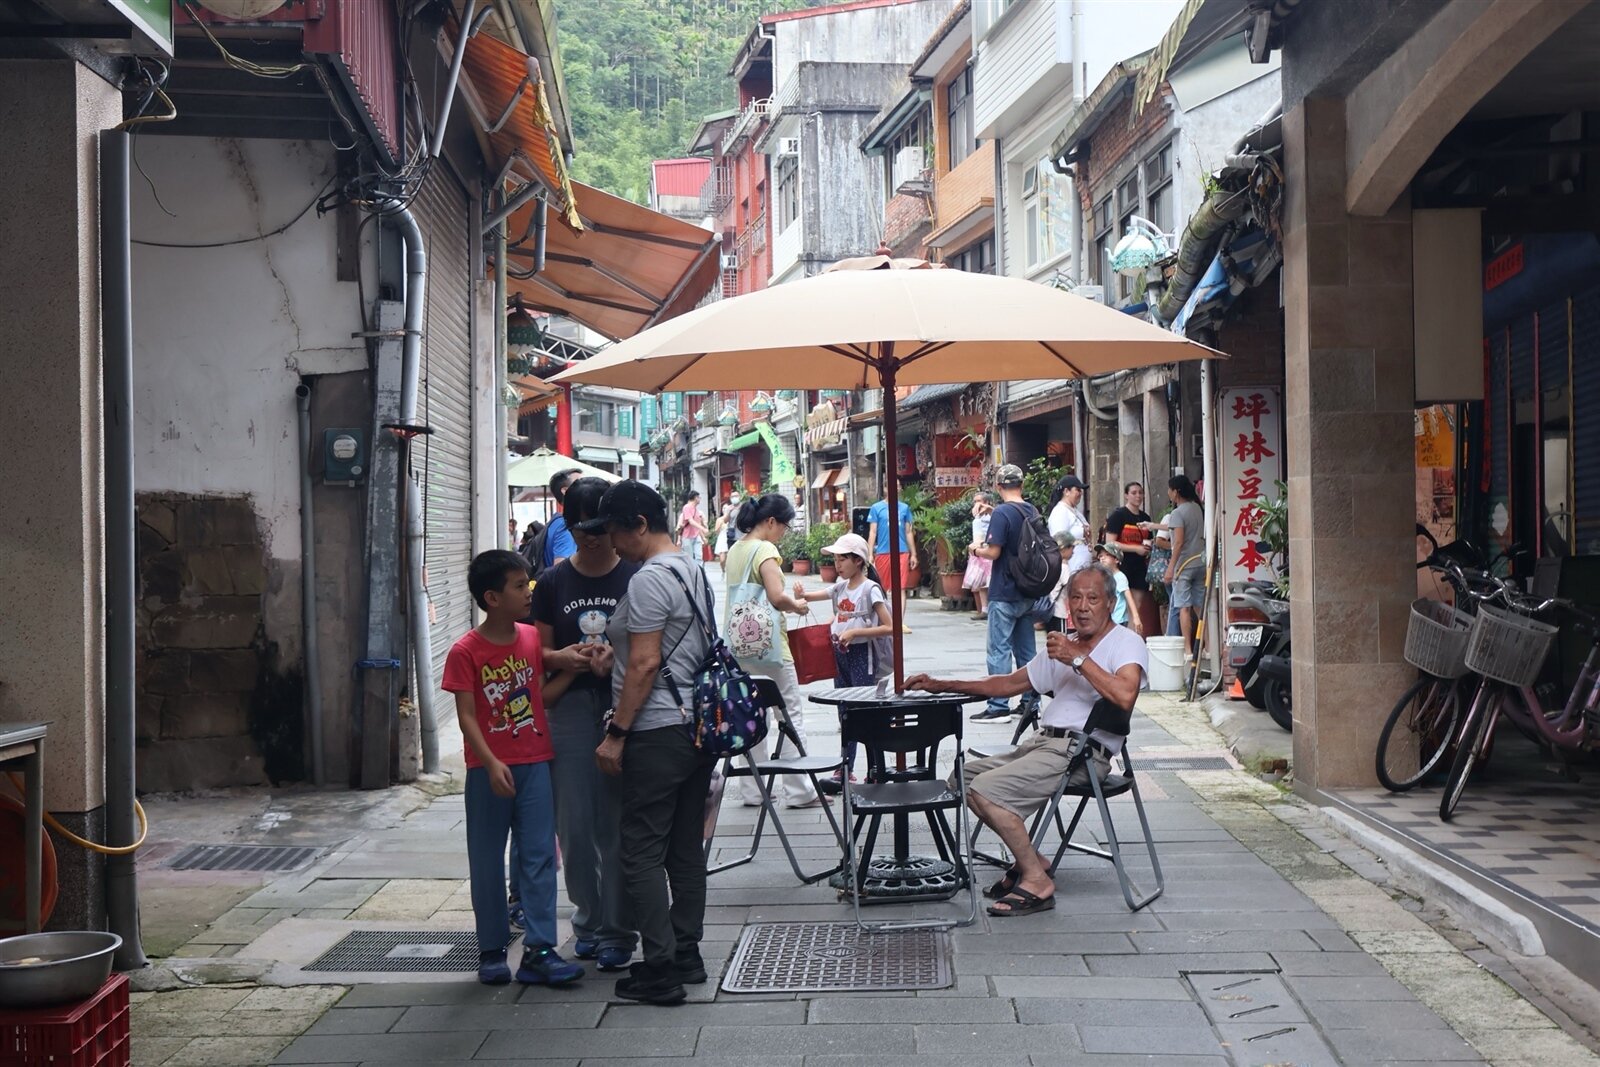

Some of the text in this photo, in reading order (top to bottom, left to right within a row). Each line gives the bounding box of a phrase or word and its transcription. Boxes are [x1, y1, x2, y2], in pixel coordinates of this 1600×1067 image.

[1231, 393, 1276, 583] 坪林豆腐本
[563, 597, 617, 614] DORAEMO
[481, 654, 528, 685] Are You
